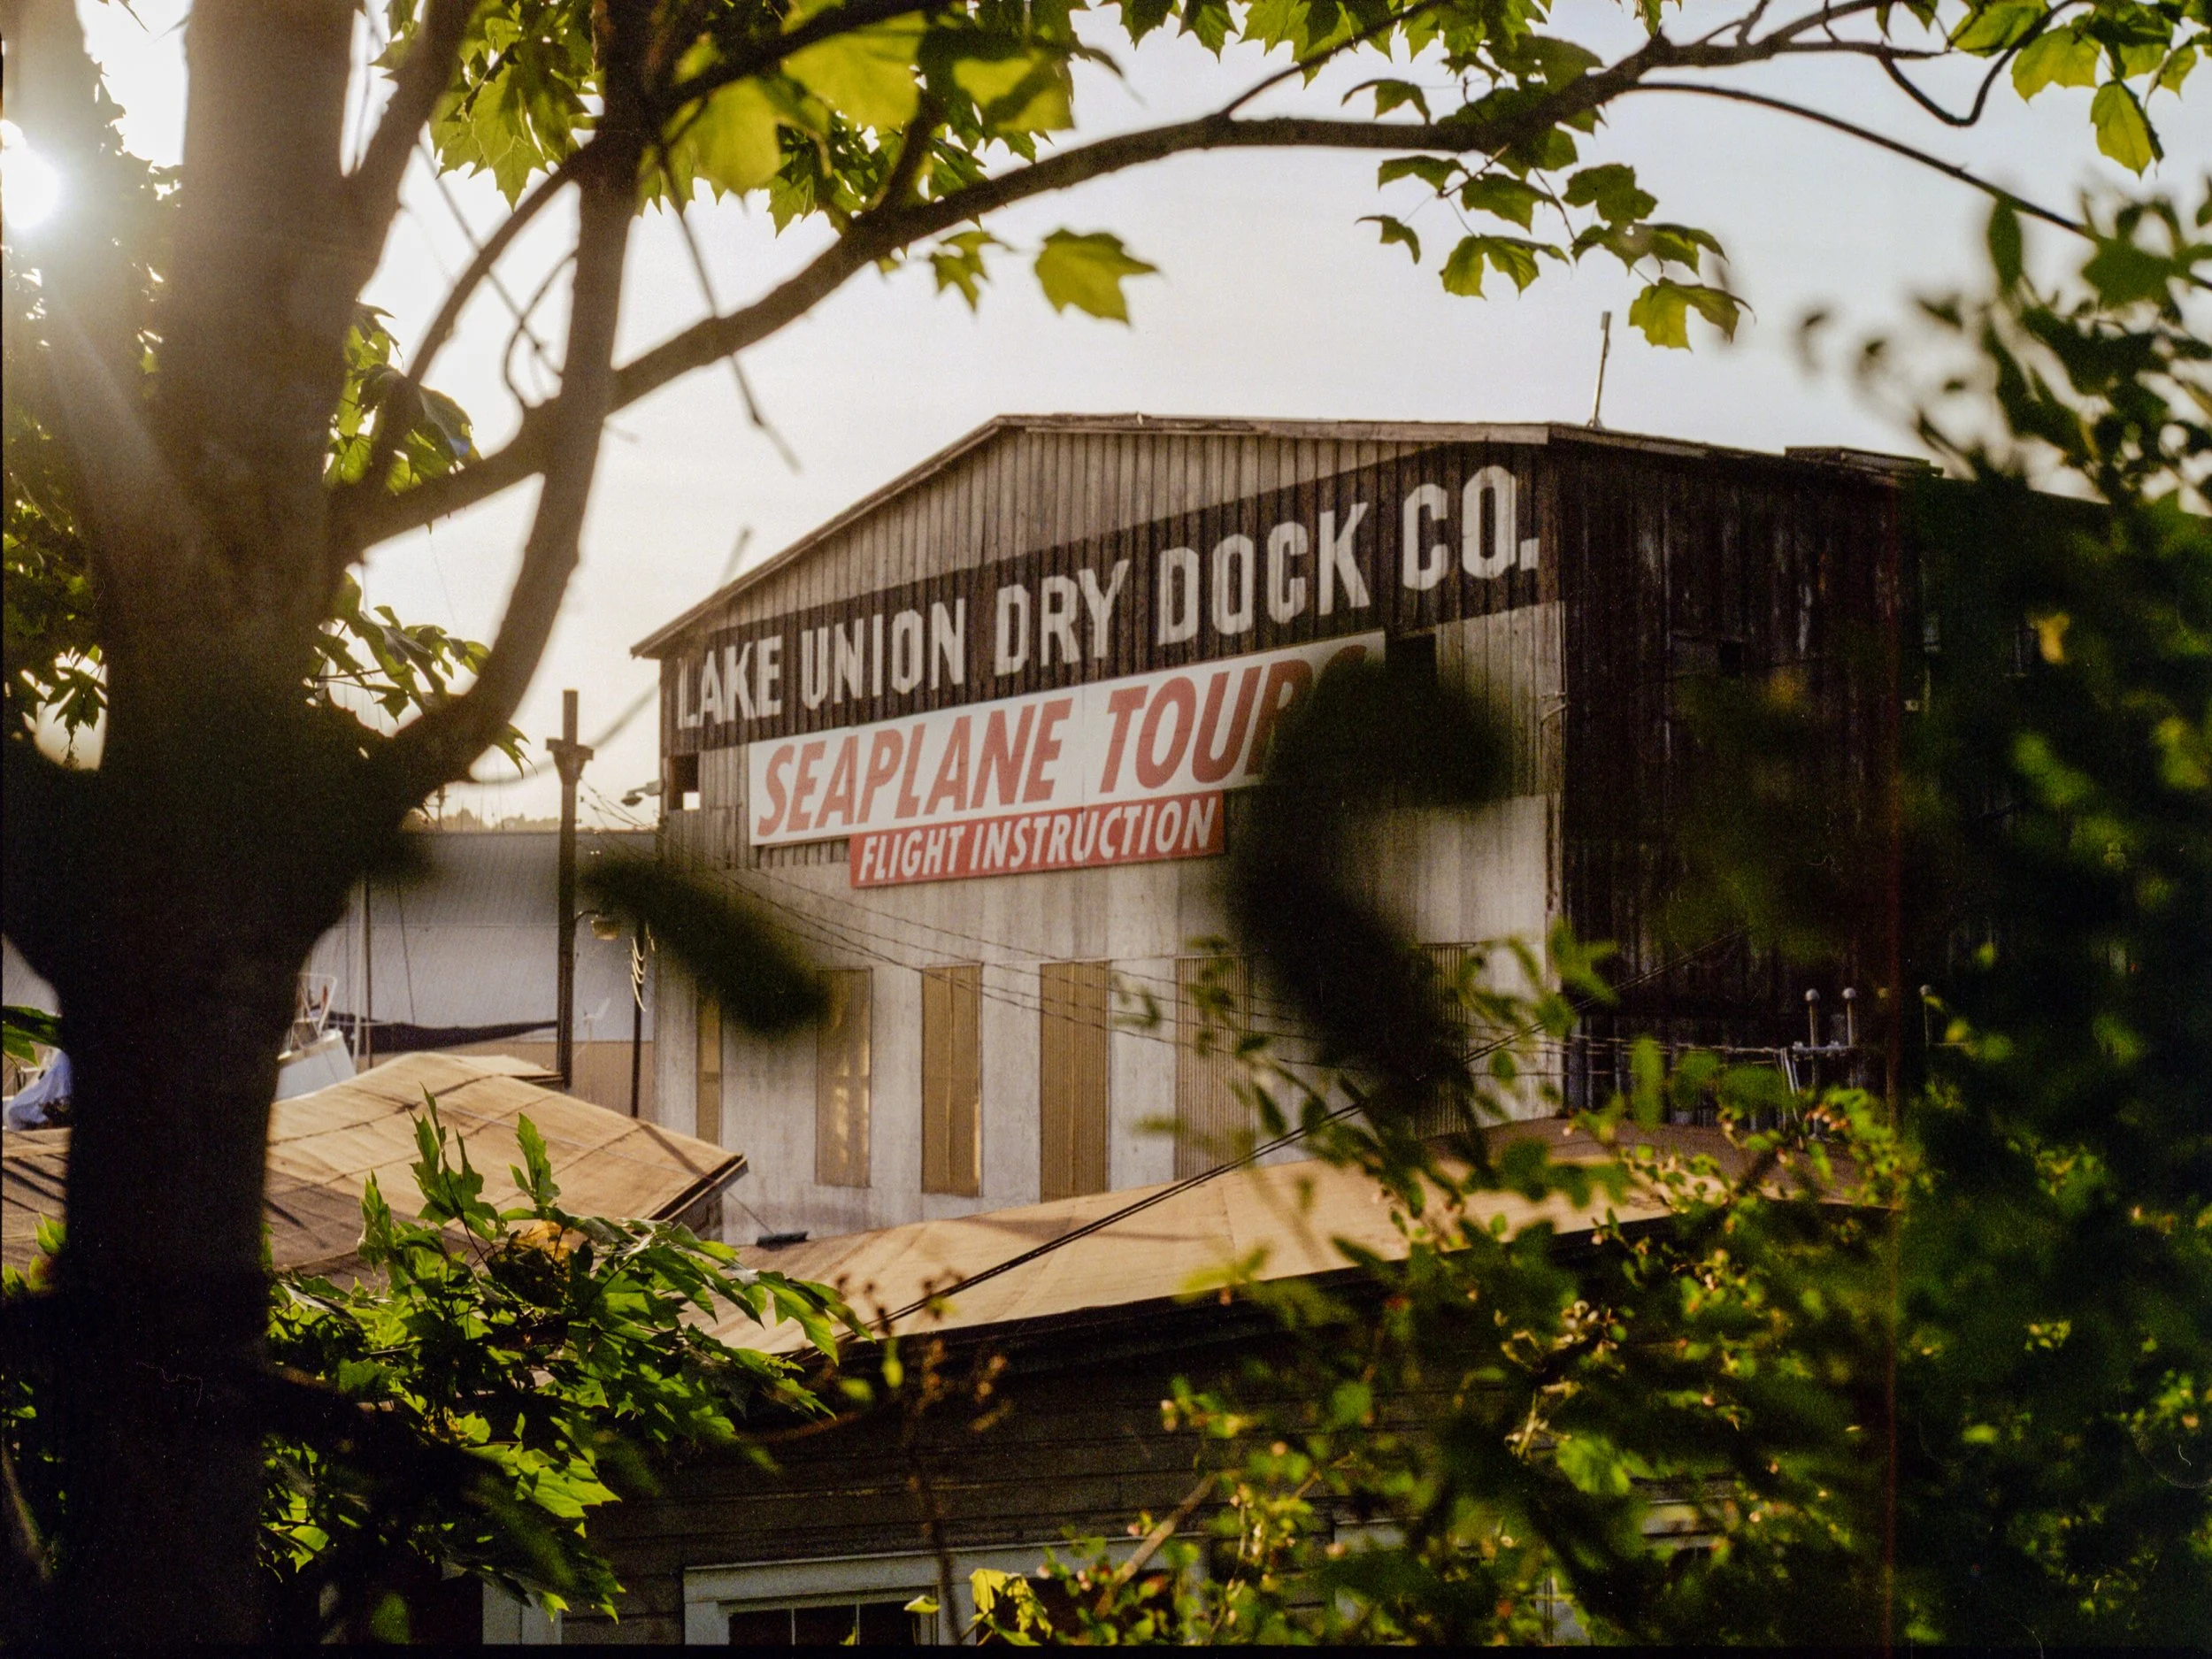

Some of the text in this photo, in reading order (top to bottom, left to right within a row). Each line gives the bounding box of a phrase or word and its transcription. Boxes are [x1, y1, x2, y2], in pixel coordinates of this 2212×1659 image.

[677, 464, 1540, 730] LAKE UNION DRY DOCK CO.
[757, 644, 1368, 837] SEAPLANE TOUR
[858, 796, 1217, 882] FLIGHT INSTRUCTION
